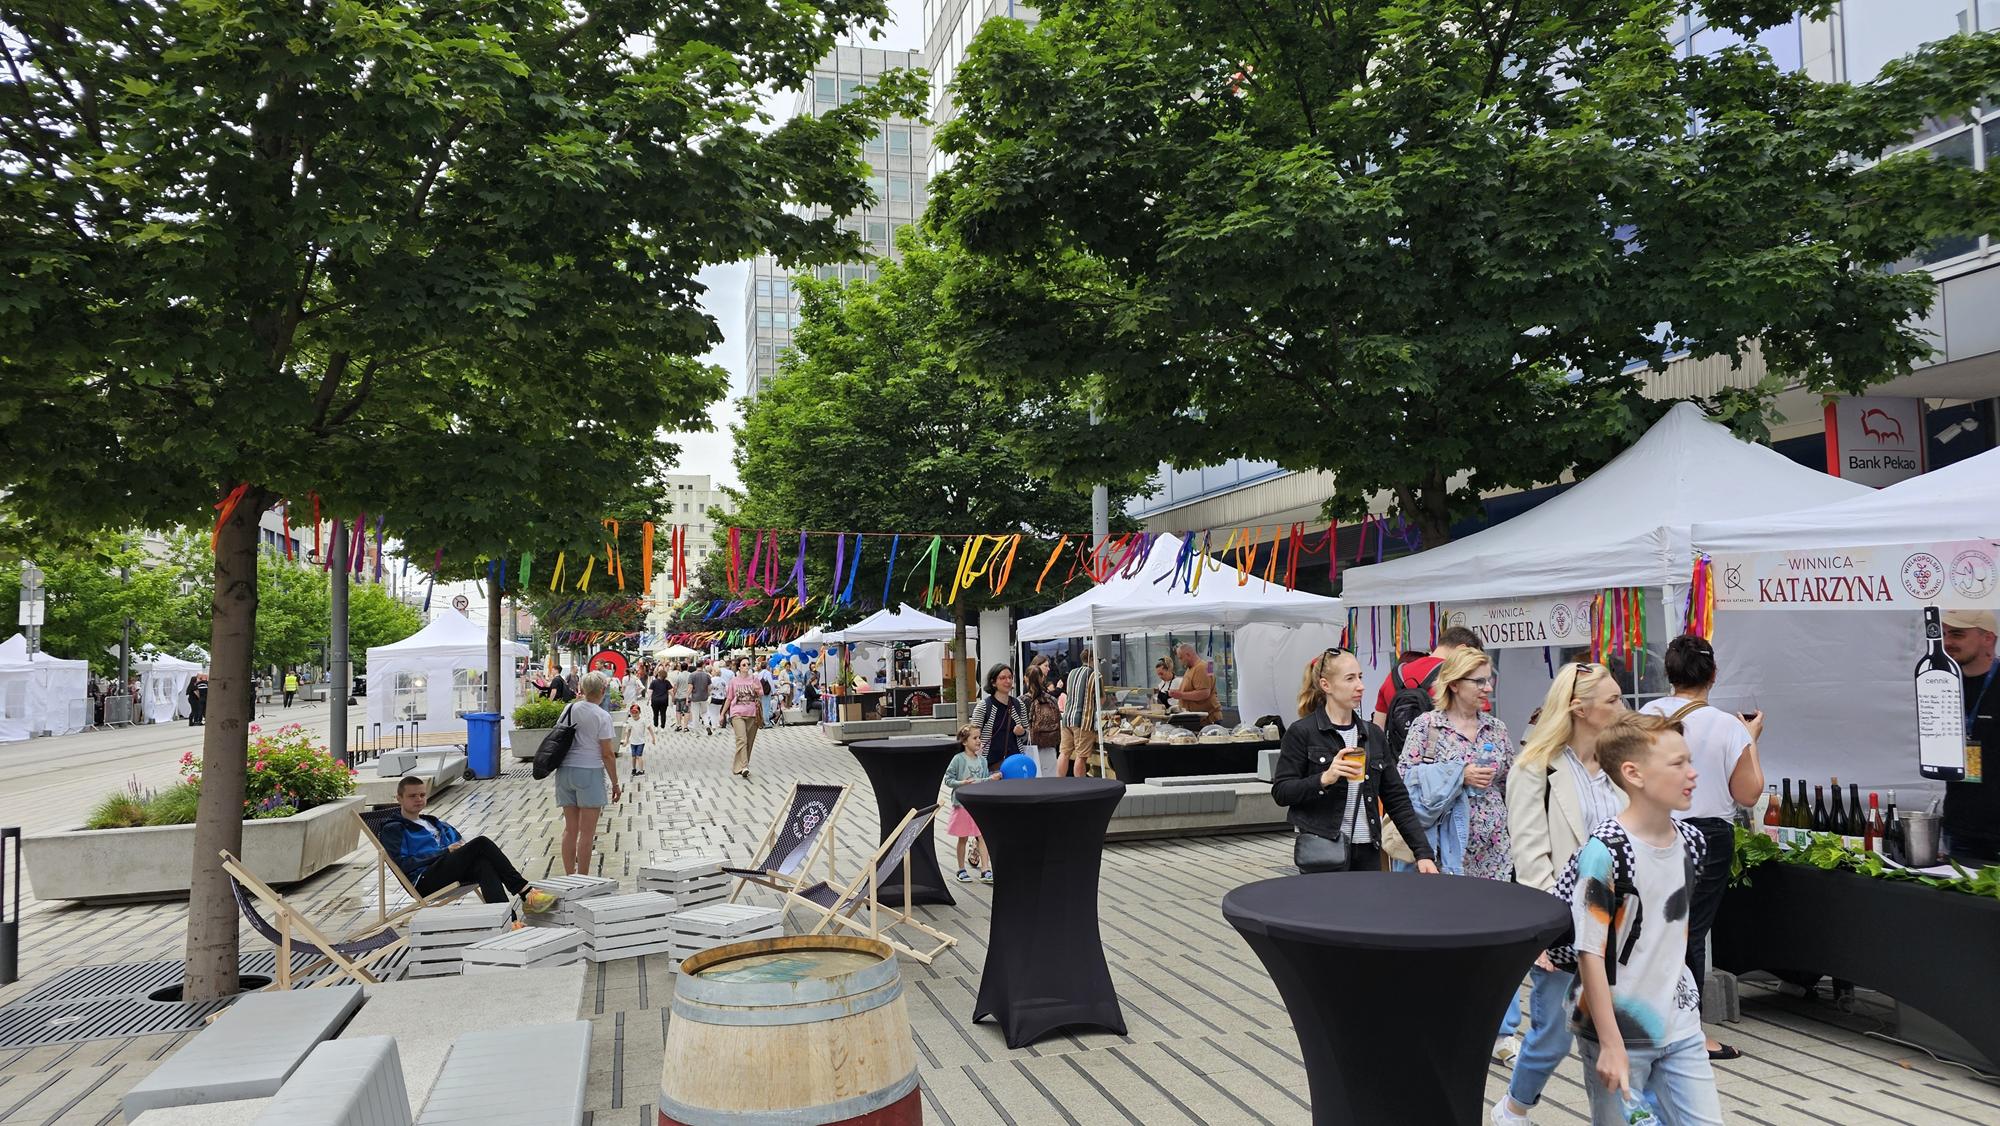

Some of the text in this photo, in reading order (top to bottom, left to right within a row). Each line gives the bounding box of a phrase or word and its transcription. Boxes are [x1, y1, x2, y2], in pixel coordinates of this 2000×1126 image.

[1848, 455, 1916, 470] Bank Pekao
[1788, 556, 1854, 571] WINNICA
[1904, 555, 1941, 574] WIELKOPOLSKI
[1758, 575, 1894, 602] KATARZYNA
[1905, 579, 1942, 596] SZLAK WINNIC
[1489, 607, 1524, 619] WINNICA
[1925, 677, 1949, 685] cennik
